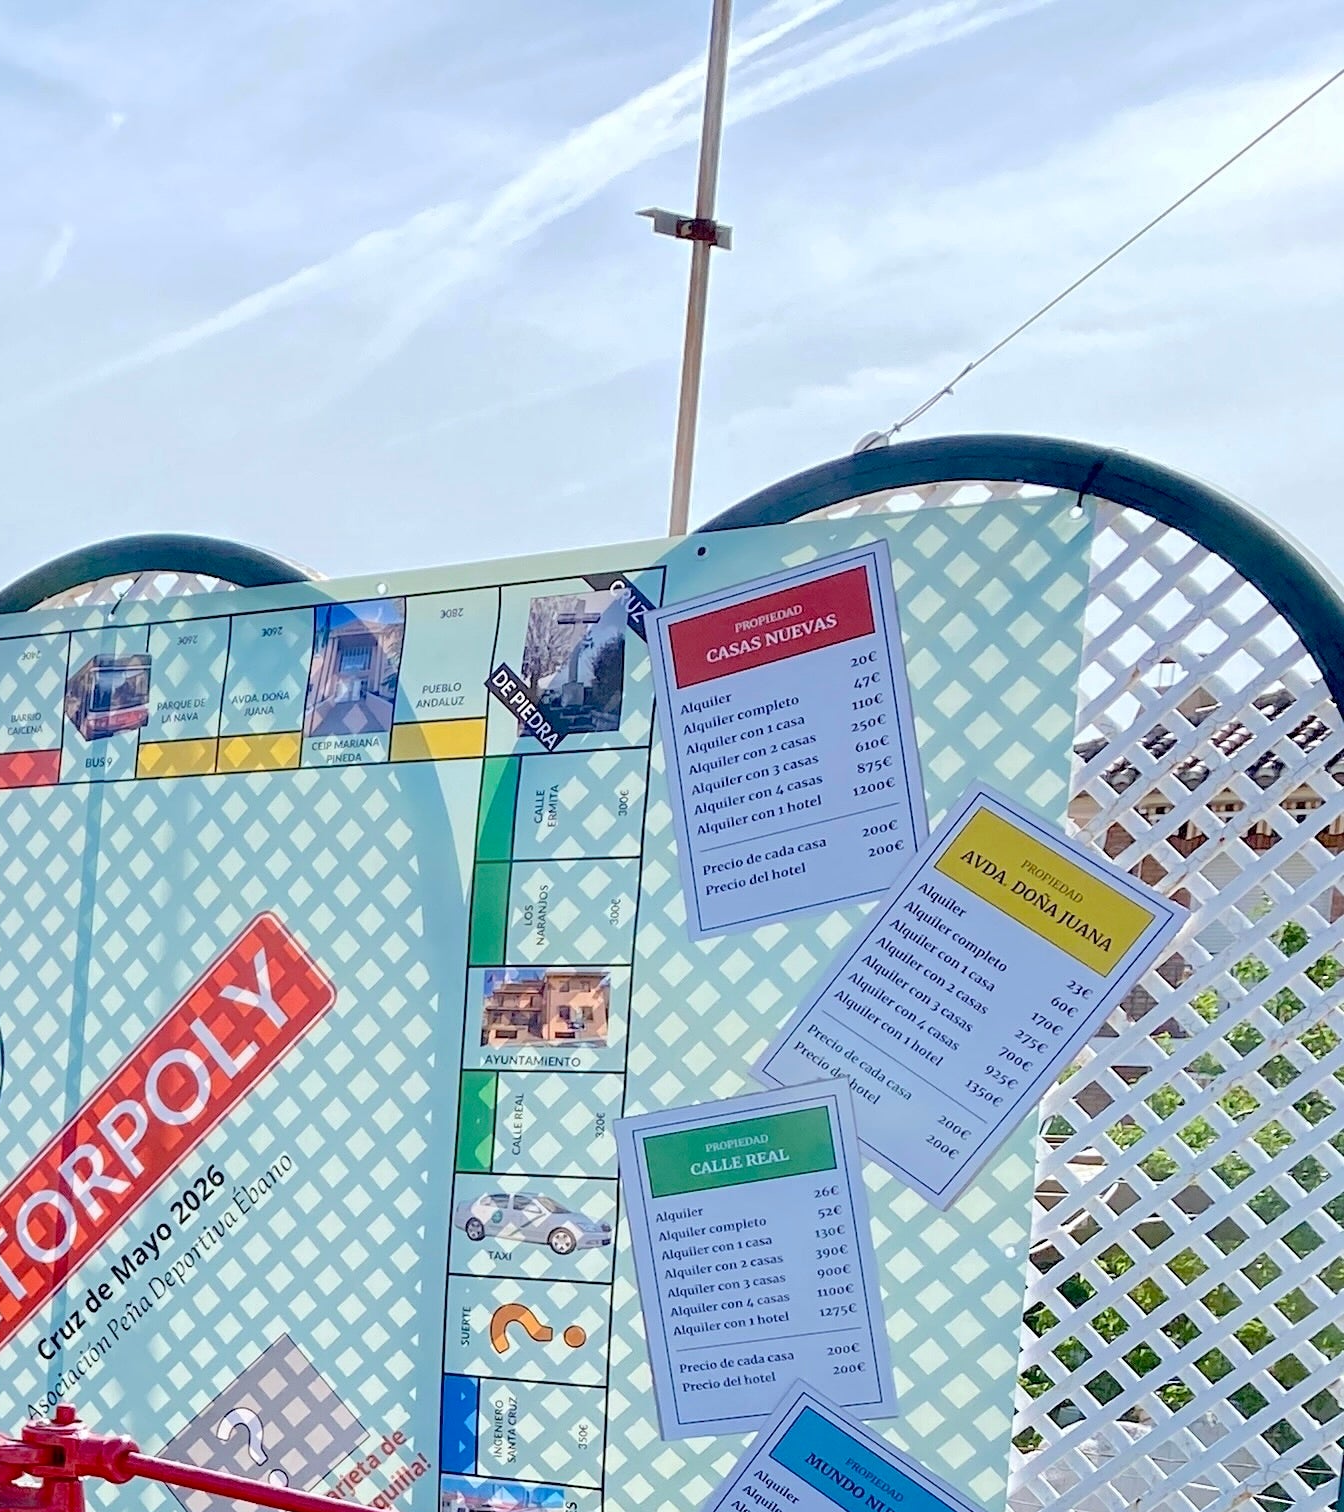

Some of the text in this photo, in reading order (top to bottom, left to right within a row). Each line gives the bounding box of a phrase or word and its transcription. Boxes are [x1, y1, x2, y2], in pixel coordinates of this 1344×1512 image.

[610, 580, 650, 623] CRUZ
[734, 605, 803, 633] PROPIEDAD
[706, 614, 838, 664] CASAS NUEVAS
[850, 651, 878, 669] 20€
[422, 682, 462, 694] PUEBLO
[853, 672, 881, 689] 47€
[157, 701, 191, 712] PARQUE
[244, 705, 275, 717] JUANA
[416, 696, 465, 709] ANDALUZ
[492, 669, 561, 750] DE PIEDRA
[680, 692, 732, 716] Alquiler
[851, 693, 884, 712] 110€
[850, 714, 887, 732] 250€
[334, 738, 380, 749] MARIANA
[855, 735, 889, 753] 610€
[85, 758, 113, 768] BUS 9
[326, 753, 362, 763] PINEDA
[857, 756, 893, 774] 875€
[852, 777, 896, 798] 1200€
[534, 789, 546, 824] CALLE
[547, 784, 560, 828] ERMITA
[618, 789, 630, 816] 300€
[862, 820, 898, 838] 200€
[702, 839, 827, 876] Precio de cada casa
[706, 863, 807, 897] Precio del hotel
[1021, 859, 1084, 905] PROPIEDAD
[918, 881, 968, 918] Alquiler
[960, 849, 1114, 952] AVDA. DOÑA JUANA
[524, 904, 534, 926] LOS
[536, 884, 549, 946] NARANJOS
[1065, 979, 1094, 1000] 23€
[484, 1054, 581, 1067] AYUNTAMIENTO
[964, 1078, 1004, 1108] 1350€
[512, 1093, 525, 1155] CALLE REAL
[595, 1113, 606, 1138] 320€
[705, 1133, 769, 1152] PROPIEDAD
[690, 1148, 790, 1177] CALLE REAL
[814, 1185, 839, 1199] 26€
[655, 1207, 704, 1223] Alquiler
[818, 1205, 843, 1219] 52€
[37, 1164, 225, 1361] Cruz de Mayo 2026
[488, 1251, 512, 1261] TAXI
[28, 1155, 293, 1420] Asociación Peña Deportiva Ébano
[819, 1303, 858, 1318] 1275€
[461, 1306, 472, 1346] SUERTE
[493, 1399, 504, 1459] INGENIERO
[507, 1427, 518, 1463] SANTA
[324, 1454, 381, 1500] arjeta
[381, 1430, 408, 1456] de
[805, 1452, 865, 1500] MUNDO
[372, 1452, 432, 1511] quilla!
[754, 1469, 800, 1505] Alquiler
[844, 1457, 904, 1503] PROPIEDAD
